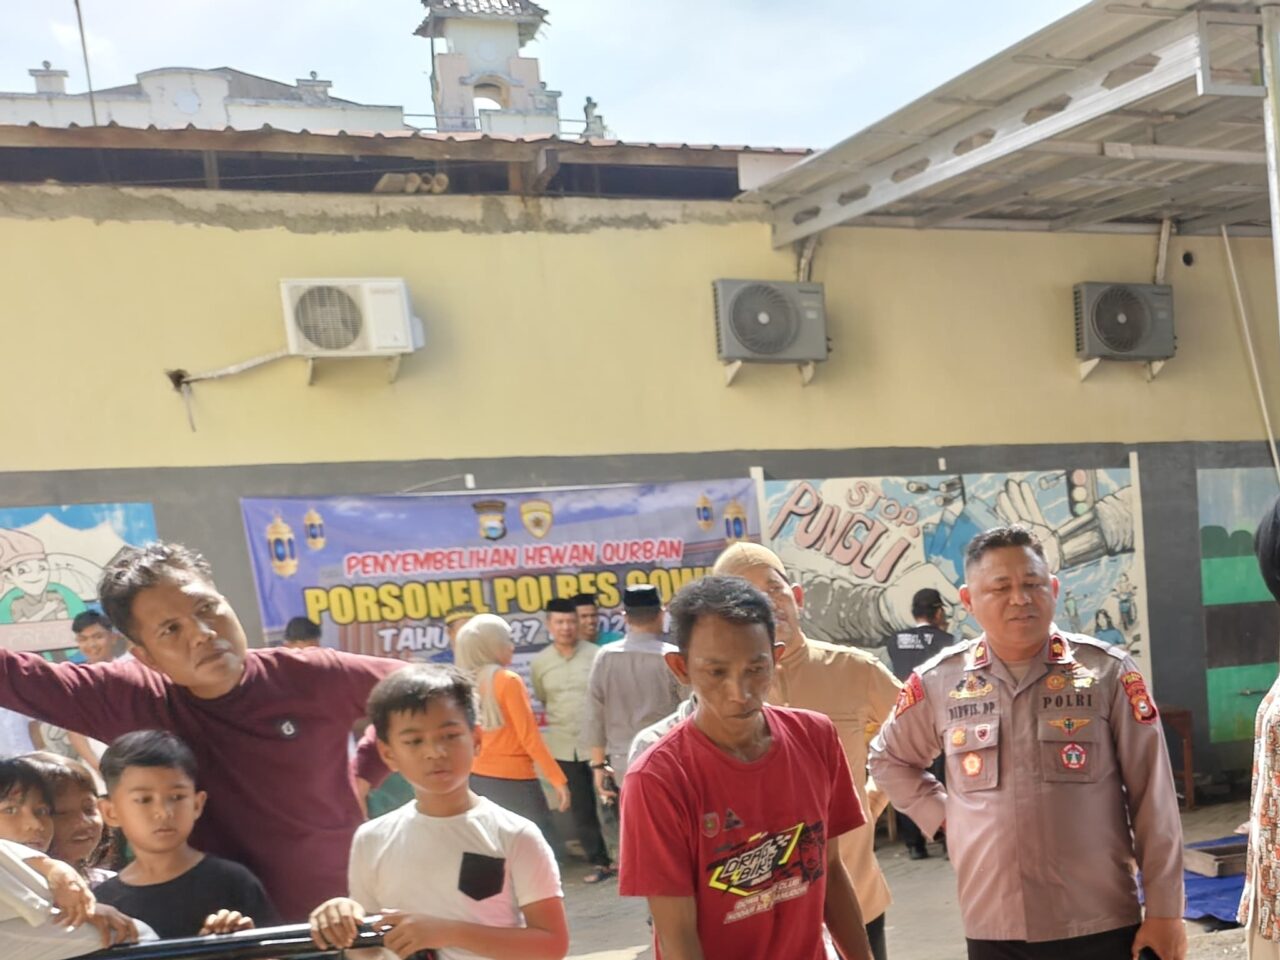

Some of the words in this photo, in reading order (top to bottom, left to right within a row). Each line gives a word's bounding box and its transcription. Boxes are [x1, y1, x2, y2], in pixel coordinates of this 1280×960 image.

[847, 481, 919, 527] STOP
[345, 547, 519, 577] PENYEMBELIHAN
[524, 542, 597, 568] HEWAN
[602, 539, 684, 564] QURBAN
[1043, 693, 1093, 709] POLRI
